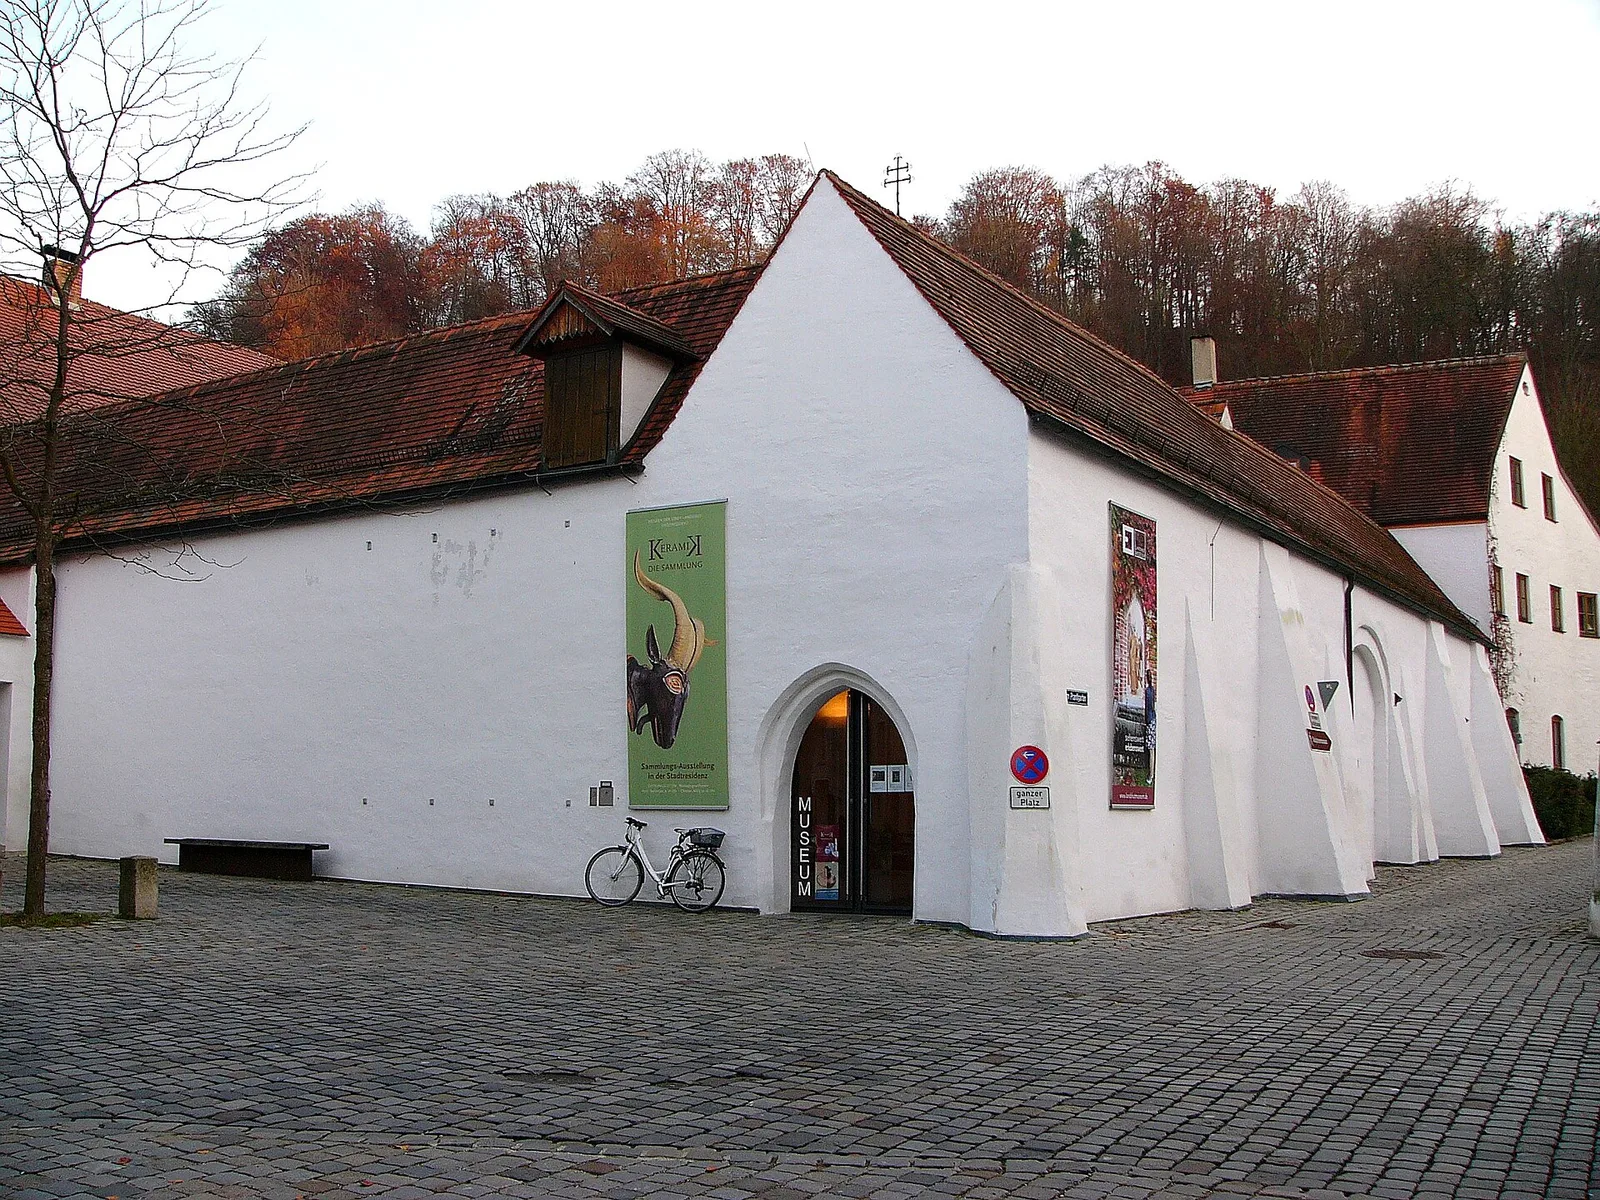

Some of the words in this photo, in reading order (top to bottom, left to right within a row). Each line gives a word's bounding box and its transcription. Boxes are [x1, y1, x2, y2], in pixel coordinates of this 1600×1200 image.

[648, 535, 703, 561] KERAMIK
[648, 565, 660, 573] DIE
[661, 561, 703, 571] SAMMLUNG
[641, 762, 715, 771] Sammlungs-Ausstellung
[1016, 791, 1043, 799] ganzer
[1020, 798, 1040, 806] Platz
[798, 797, 811, 896] MUSEUM
